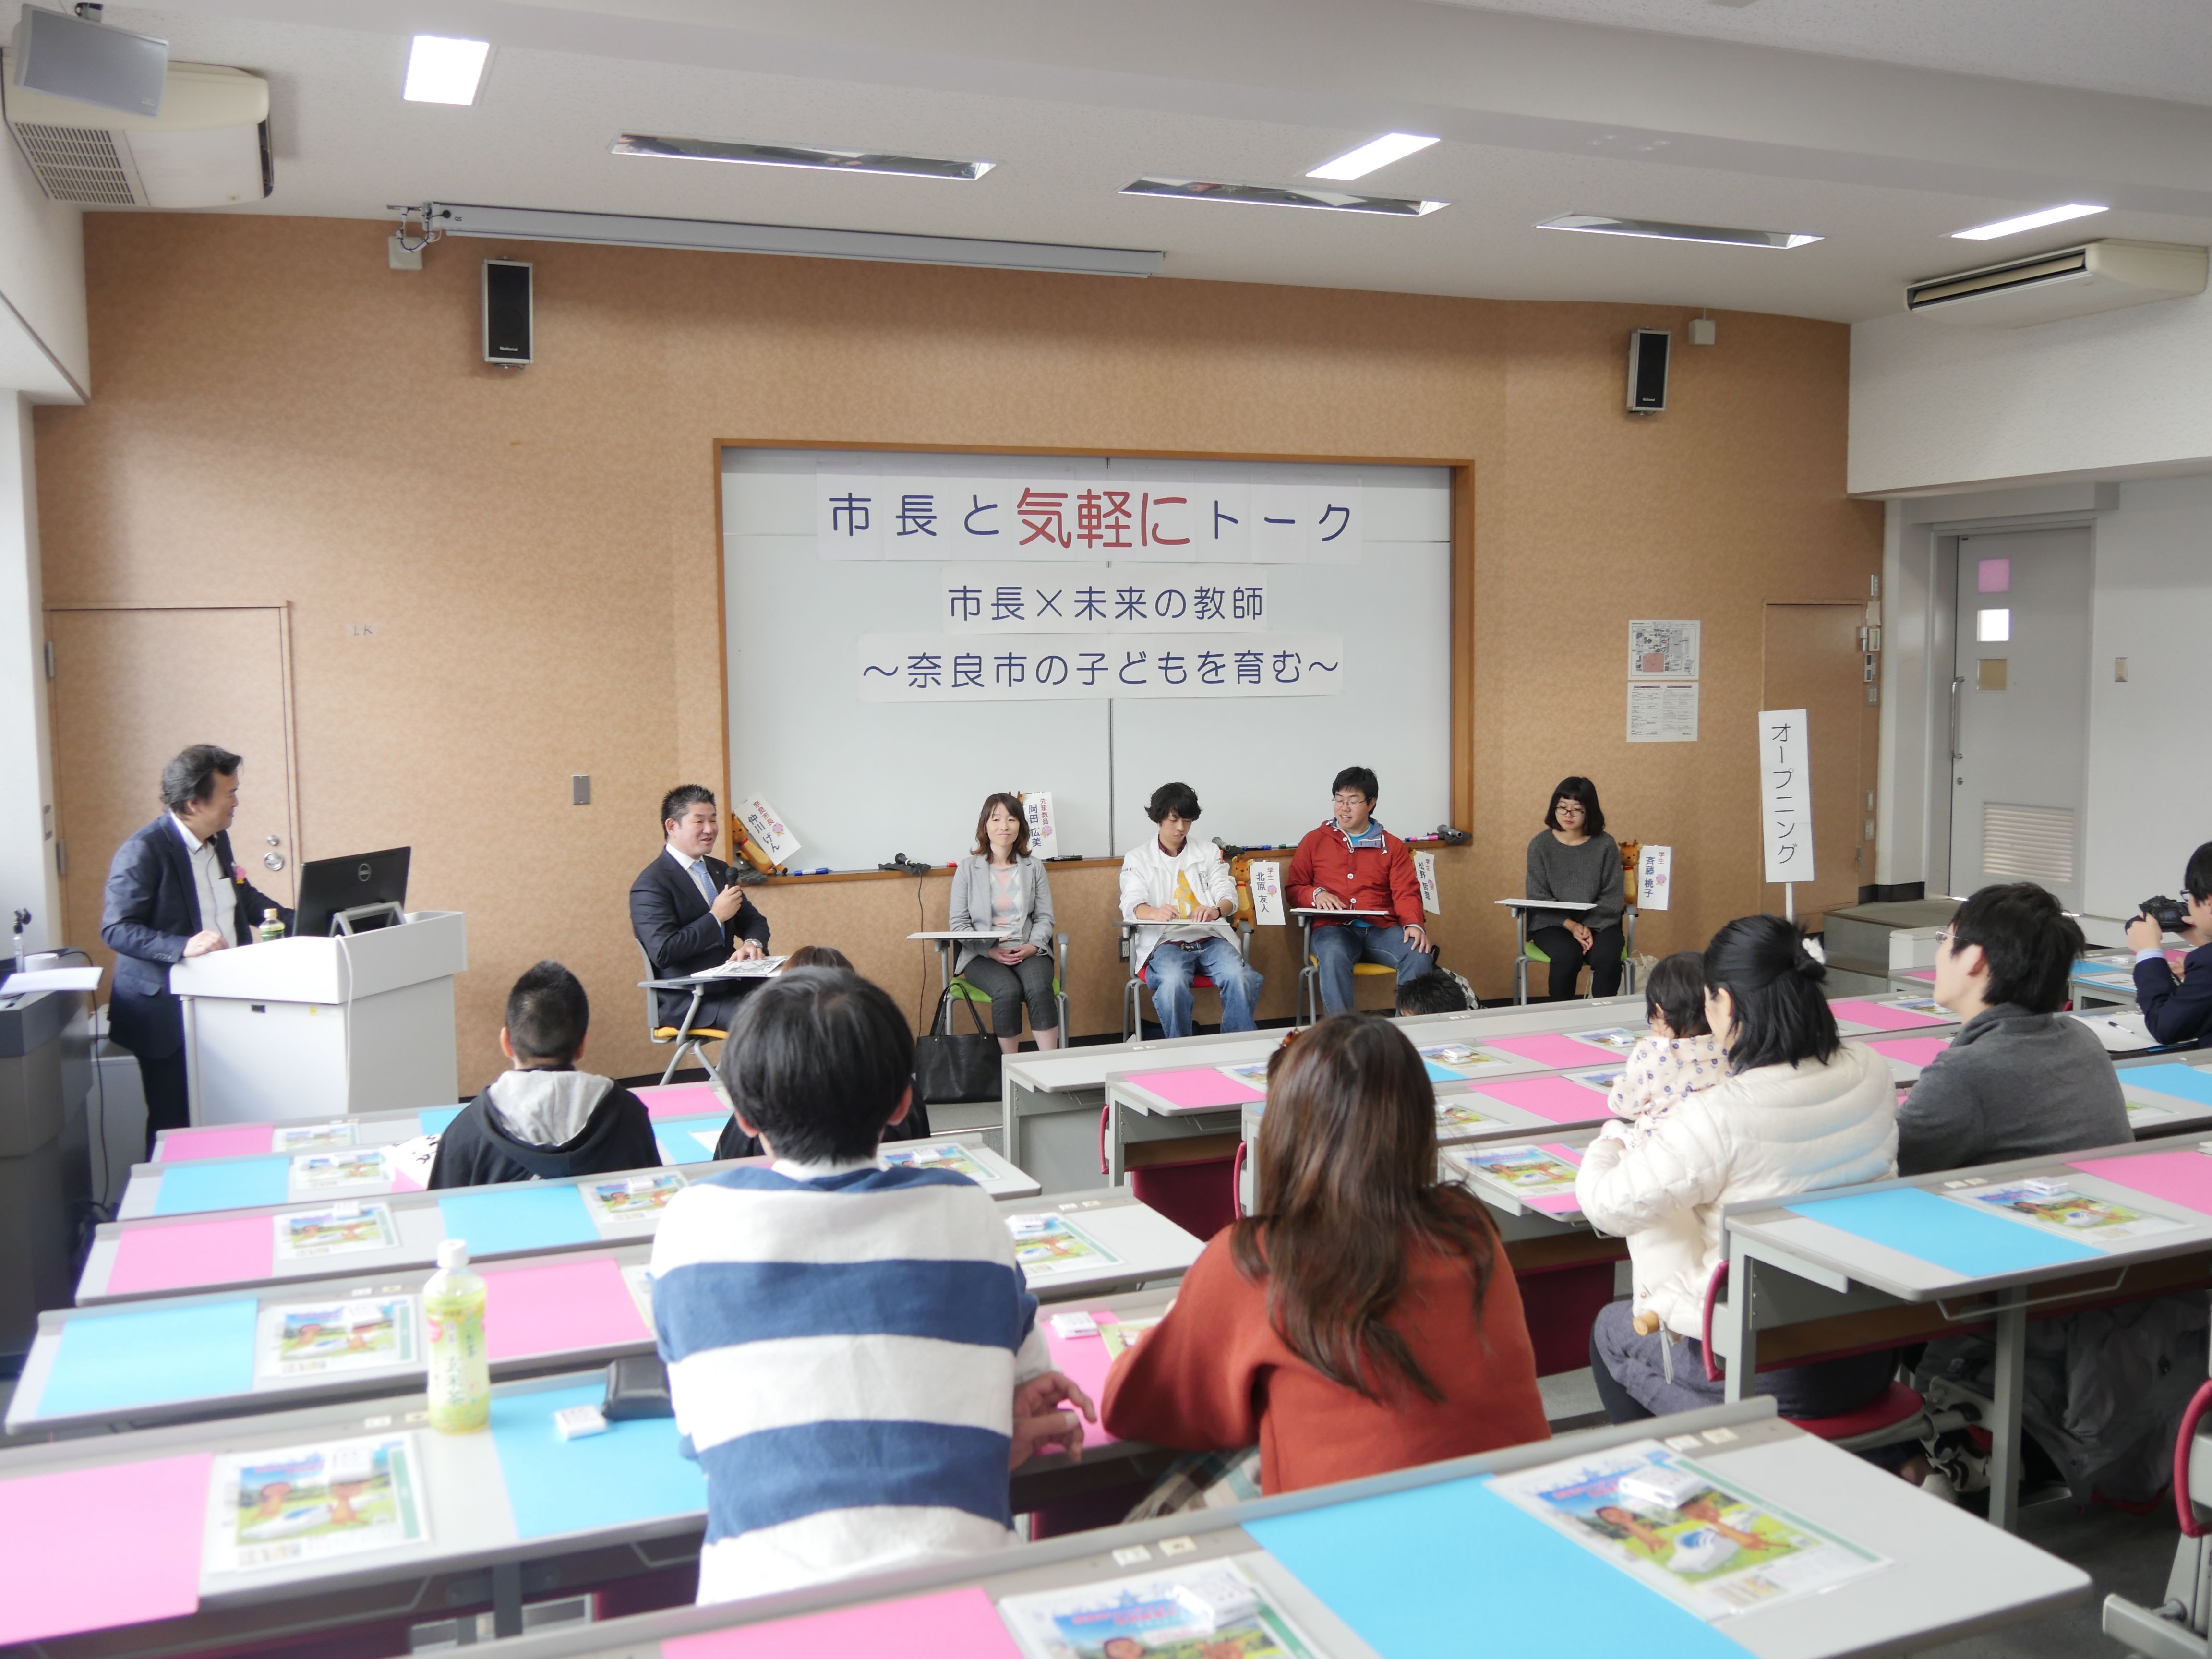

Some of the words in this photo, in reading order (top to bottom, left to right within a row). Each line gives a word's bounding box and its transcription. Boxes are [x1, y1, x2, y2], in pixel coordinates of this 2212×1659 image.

[829, 487, 1350, 549] 市長と気軽にトーク
[948, 584, 1264, 621] 市長×未来の教師
[1772, 723, 1798, 864] オープニング
[753, 800, 775, 826] 奈良市長
[1658, 851, 1665, 865] 学生
[1267, 867, 1274, 881] 学生
